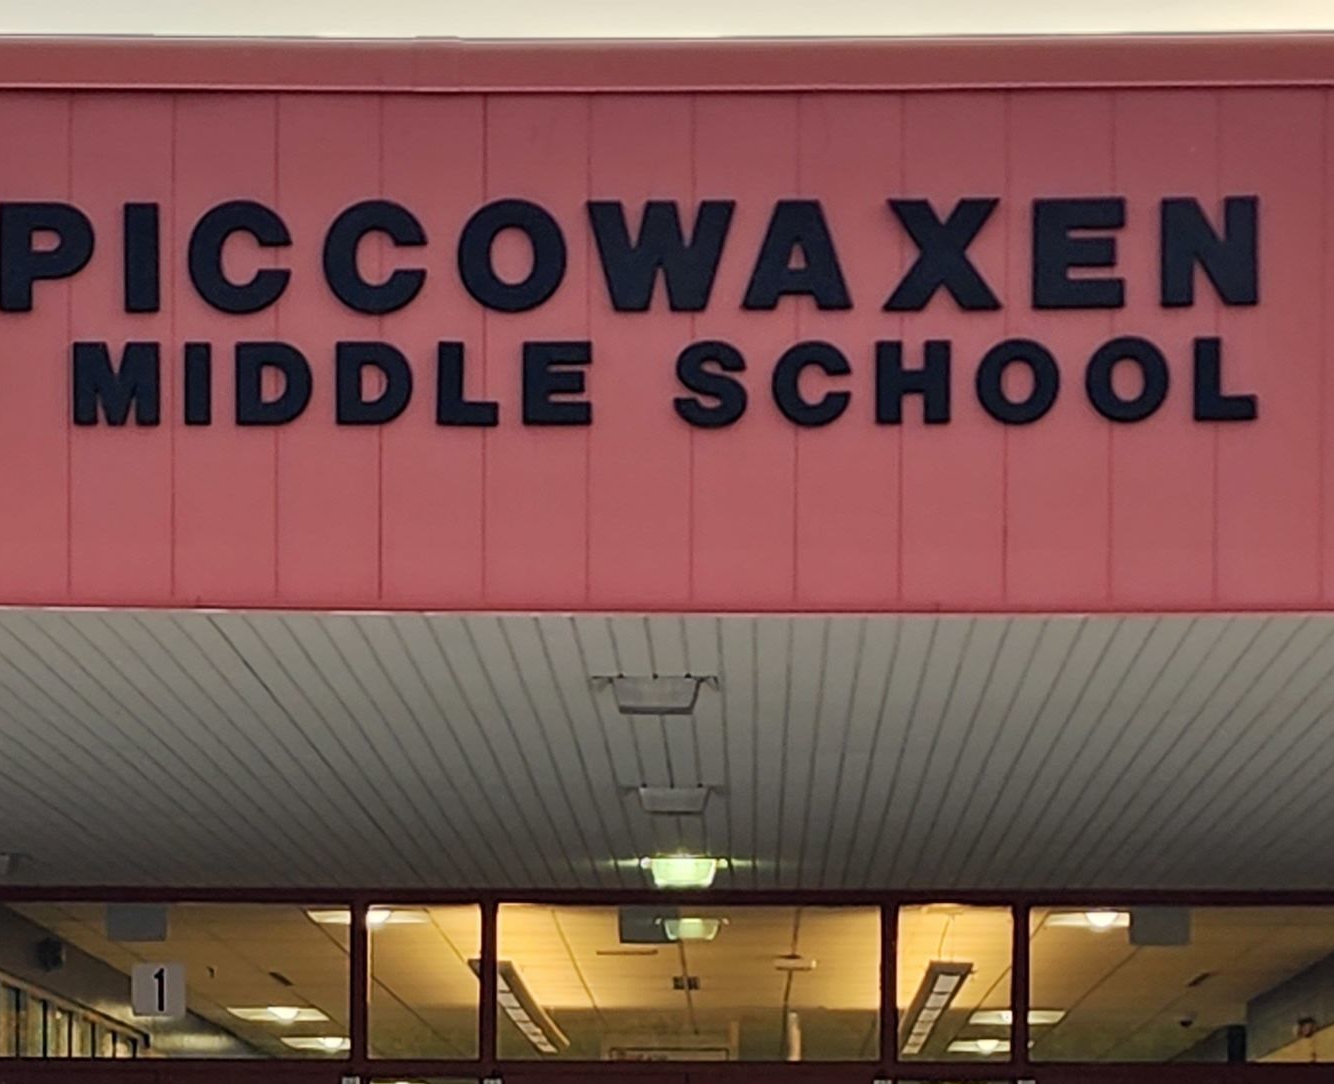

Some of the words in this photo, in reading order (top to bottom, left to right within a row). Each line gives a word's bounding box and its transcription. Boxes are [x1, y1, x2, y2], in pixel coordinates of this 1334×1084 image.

[72, 341, 593, 428] MIDDLE
[673, 336, 1258, 429] SCHOOL
[153, 967, 165, 1012] 1
